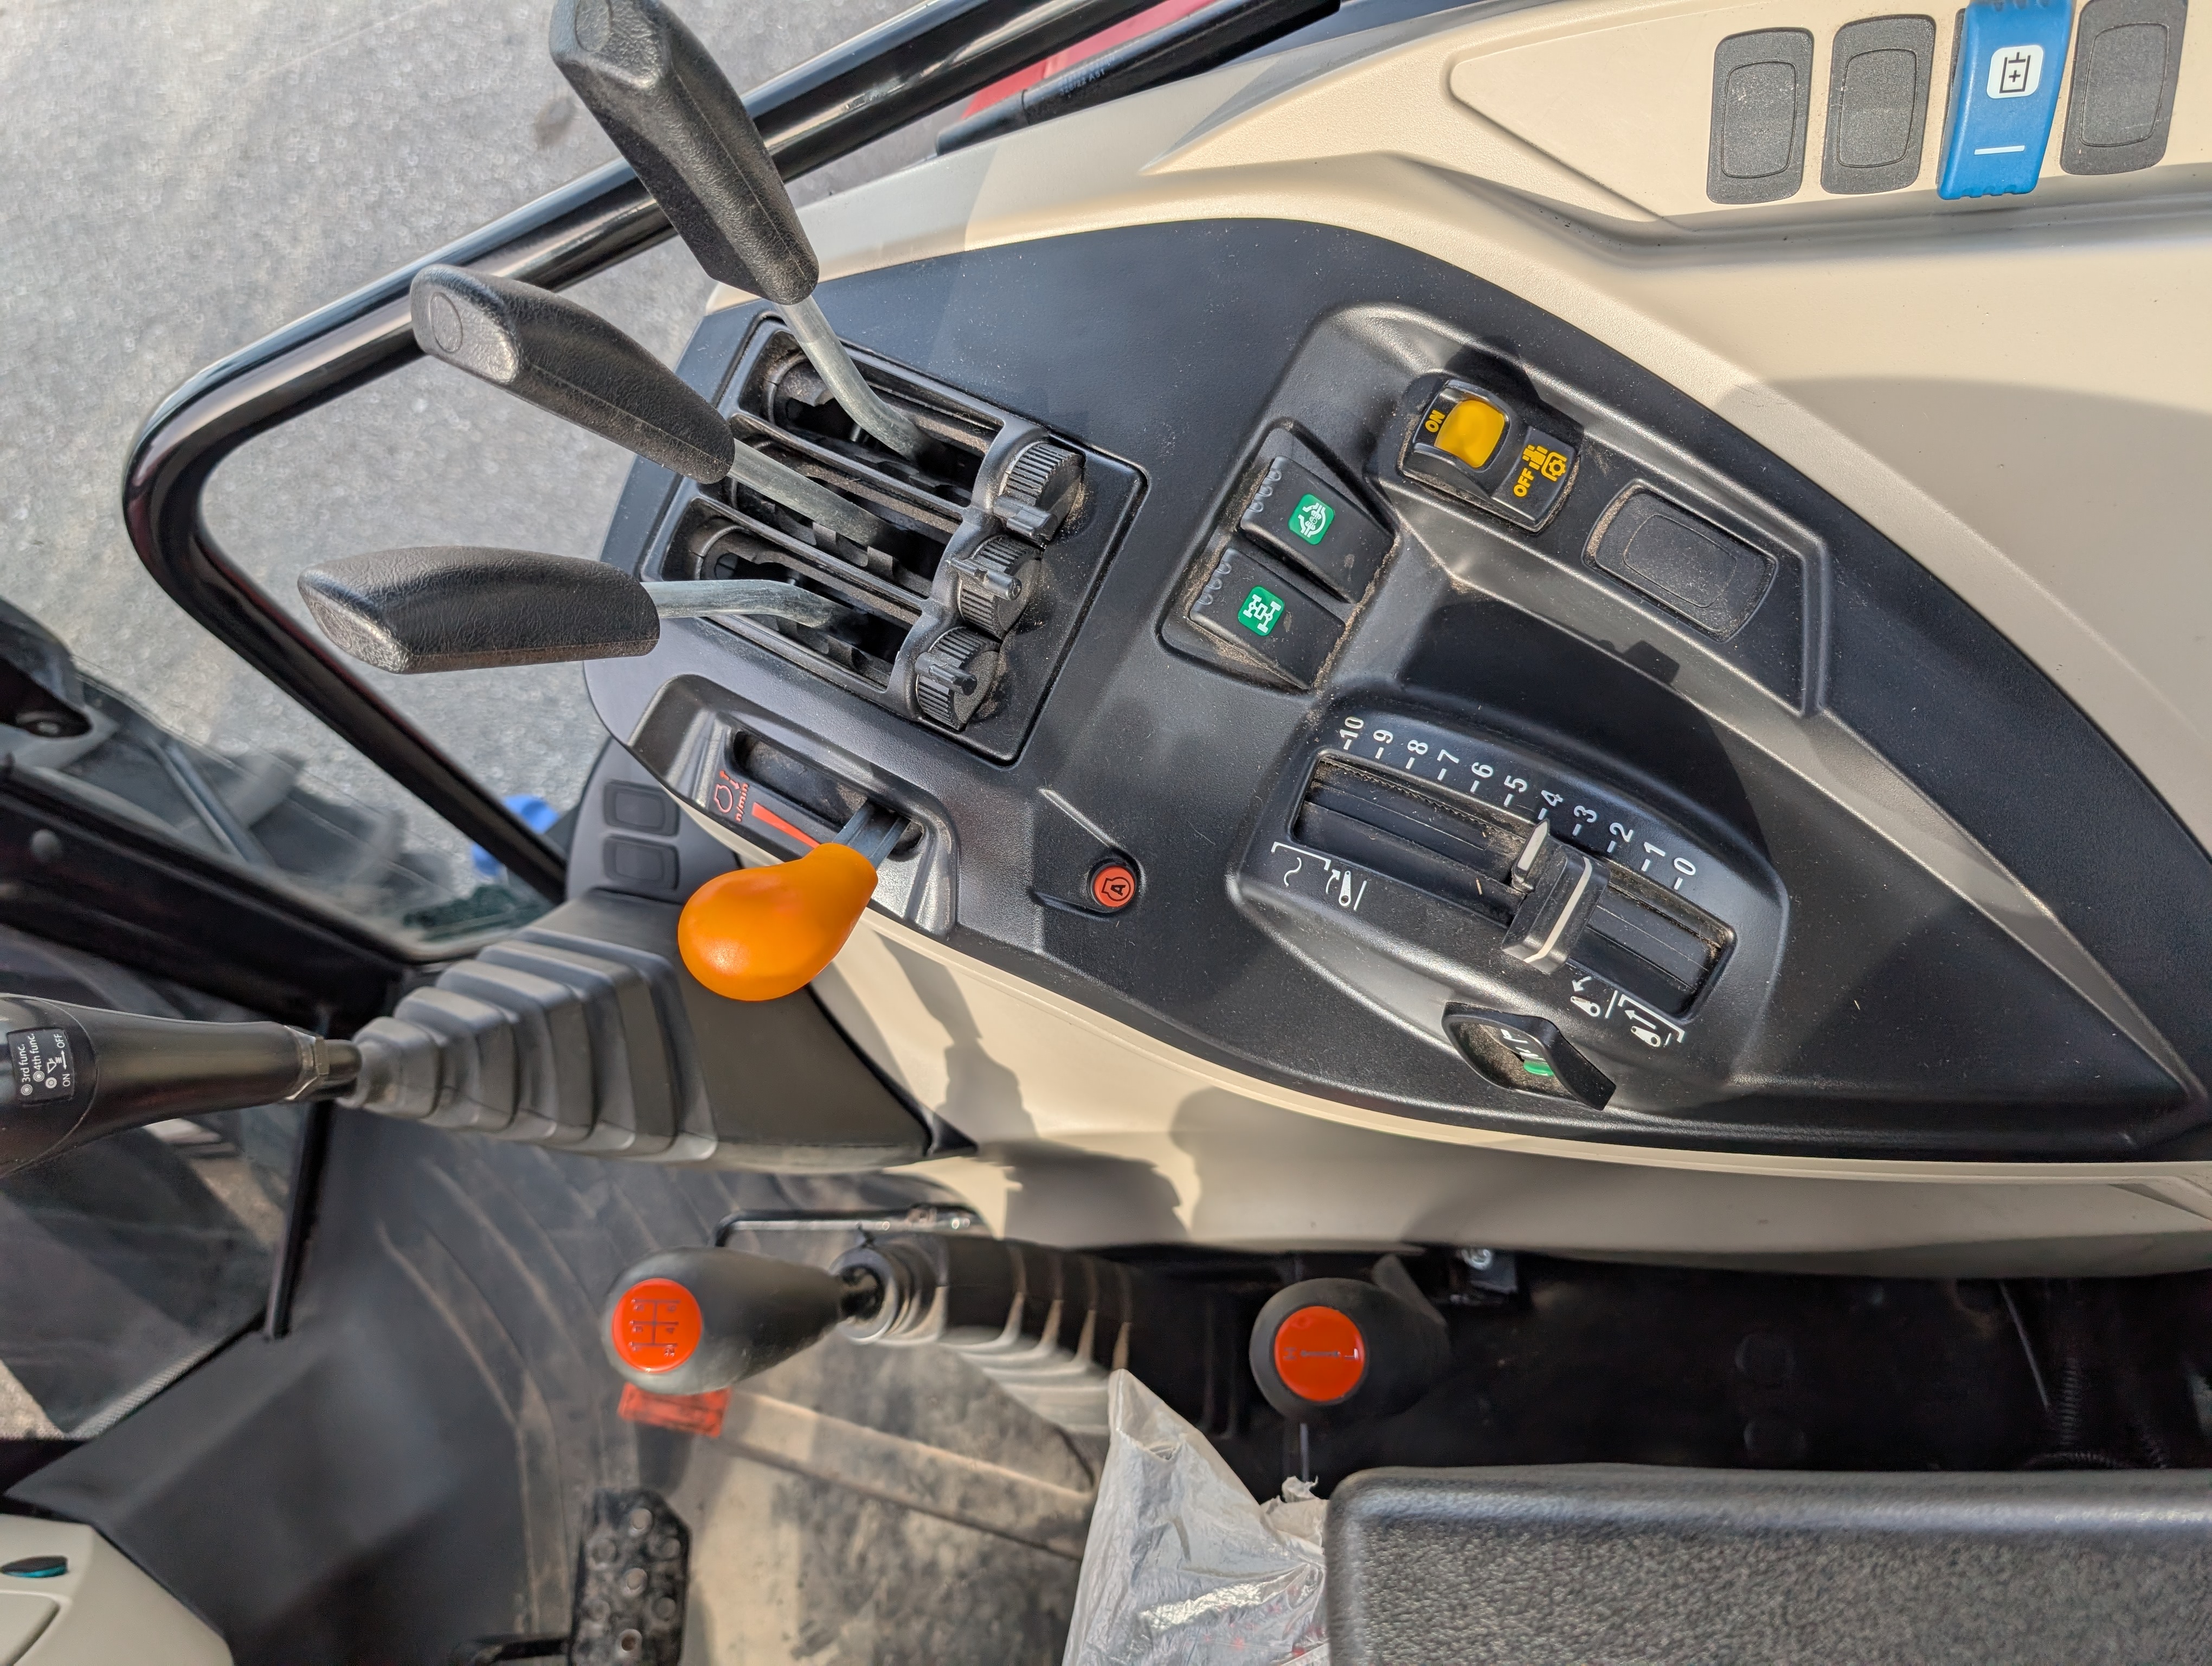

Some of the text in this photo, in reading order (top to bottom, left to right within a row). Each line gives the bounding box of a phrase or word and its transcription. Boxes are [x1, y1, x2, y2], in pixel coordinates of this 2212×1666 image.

[1425, 409, 1445, 433] ON
[1513, 468, 1535, 497] OFF
[1339, 716, 1364, 738] 10
[1373, 729, 1393, 744] 9
[1407, 739, 1428, 755] 8
[1437, 749, 1459, 764] 7
[1471, 762, 1493, 778] 6
[1504, 775, 1527, 792] 5
[735, 783, 748, 822] n/min
[1541, 790, 1564, 807] 4
[1573, 805, 1597, 823] 3
[1610, 822, 1634, 842] 2
[1644, 842, 1666, 857] 1
[1674, 857, 1696, 875] 0
[1110, 885, 1126, 896] A
[28, 1033, 42, 1070] 4th func.
[54, 1034, 70, 1087] ON OFF
[18, 1044, 31, 1082] 3rd func.
